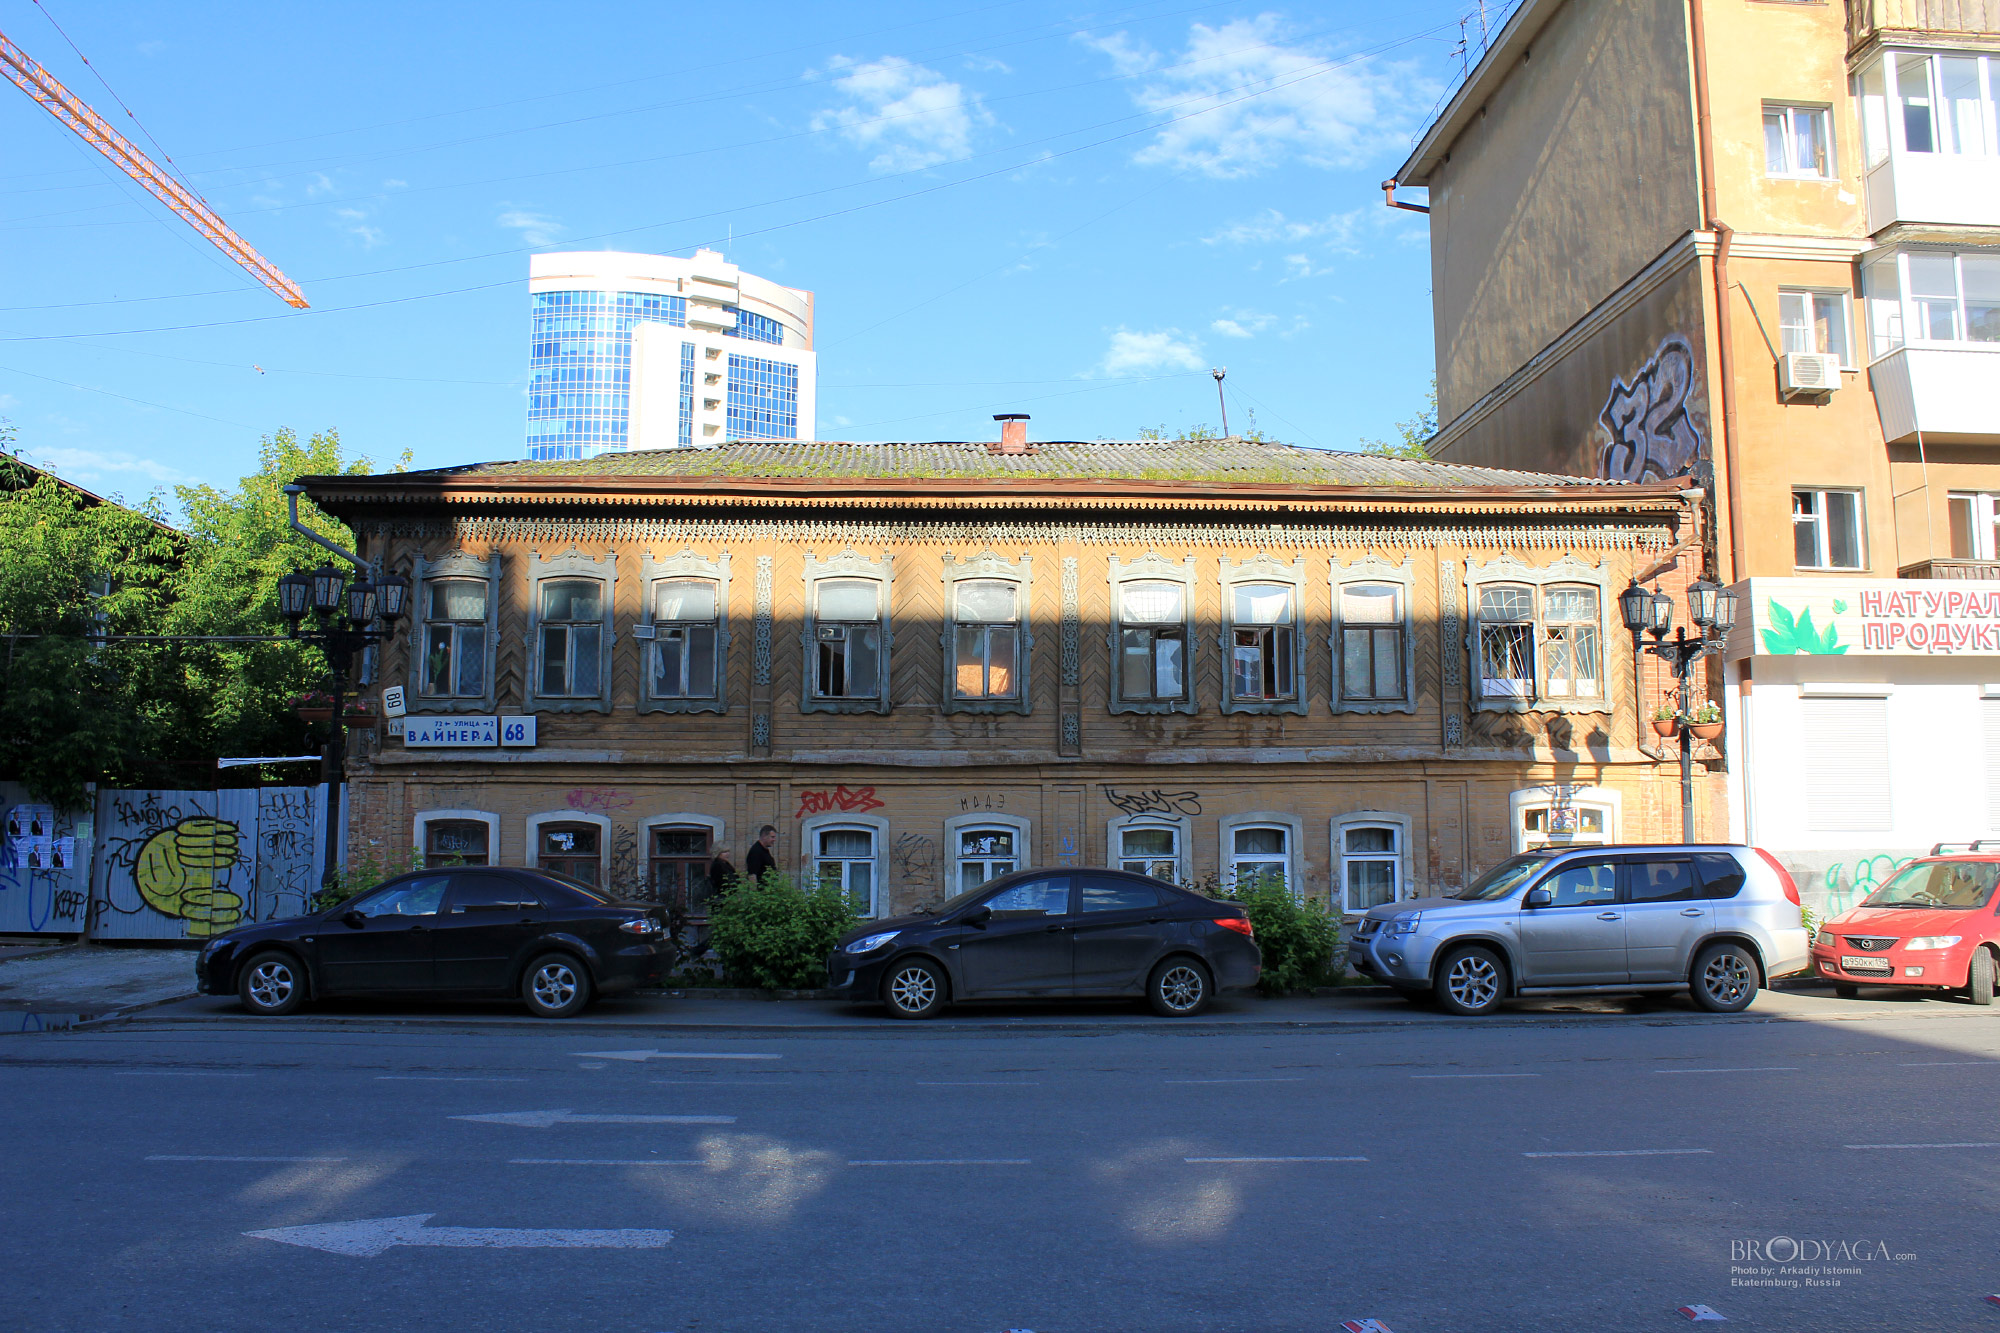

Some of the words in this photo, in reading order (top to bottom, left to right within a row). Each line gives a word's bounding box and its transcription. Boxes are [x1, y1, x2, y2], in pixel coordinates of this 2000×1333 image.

[1860, 590, 2000, 618] НАТУРАЛ
[408, 728, 494, 742] ВАЙНЕРА
[505, 723, 525, 741] 68
